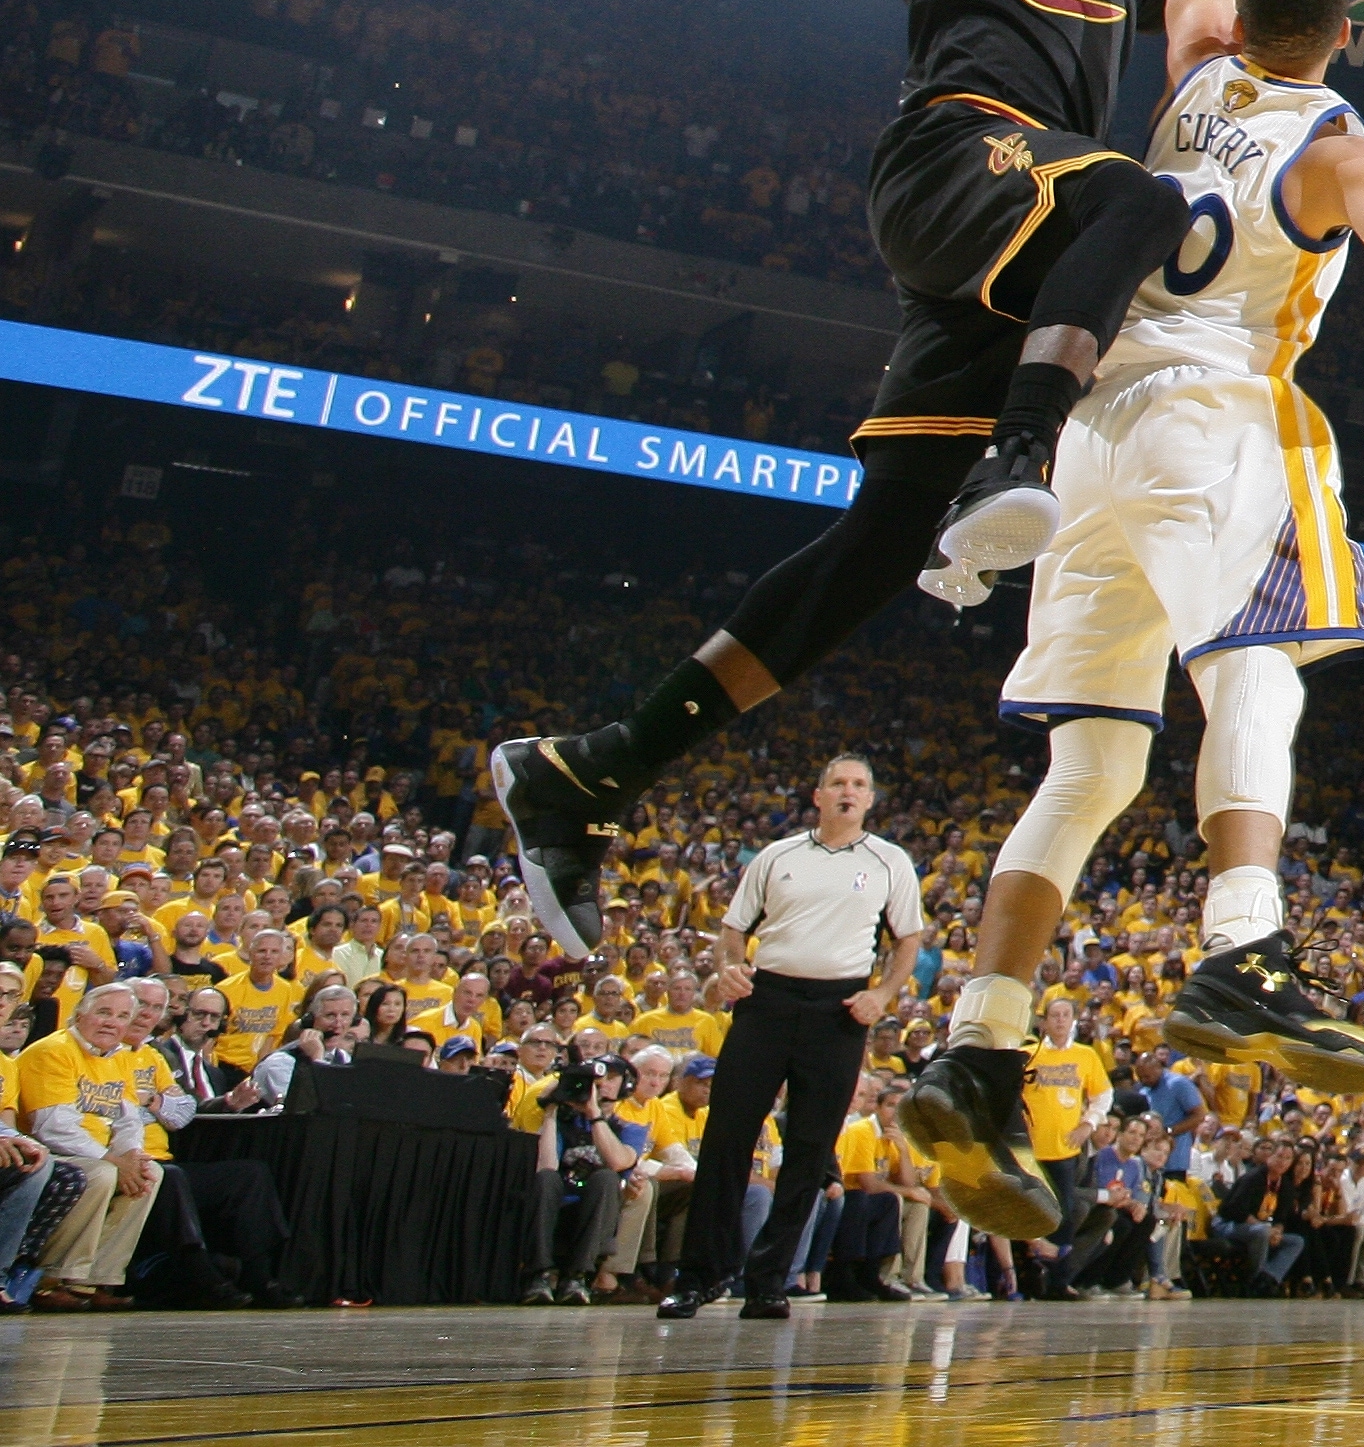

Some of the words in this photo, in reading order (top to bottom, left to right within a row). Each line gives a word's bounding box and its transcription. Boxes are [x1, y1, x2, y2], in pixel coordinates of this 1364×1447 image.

[1174, 112, 1264, 176] CURRY
[1155, 174, 1234, 296] 0
[181, 353, 304, 419] ZTE
[354, 389, 609, 463] OFFICIAL
